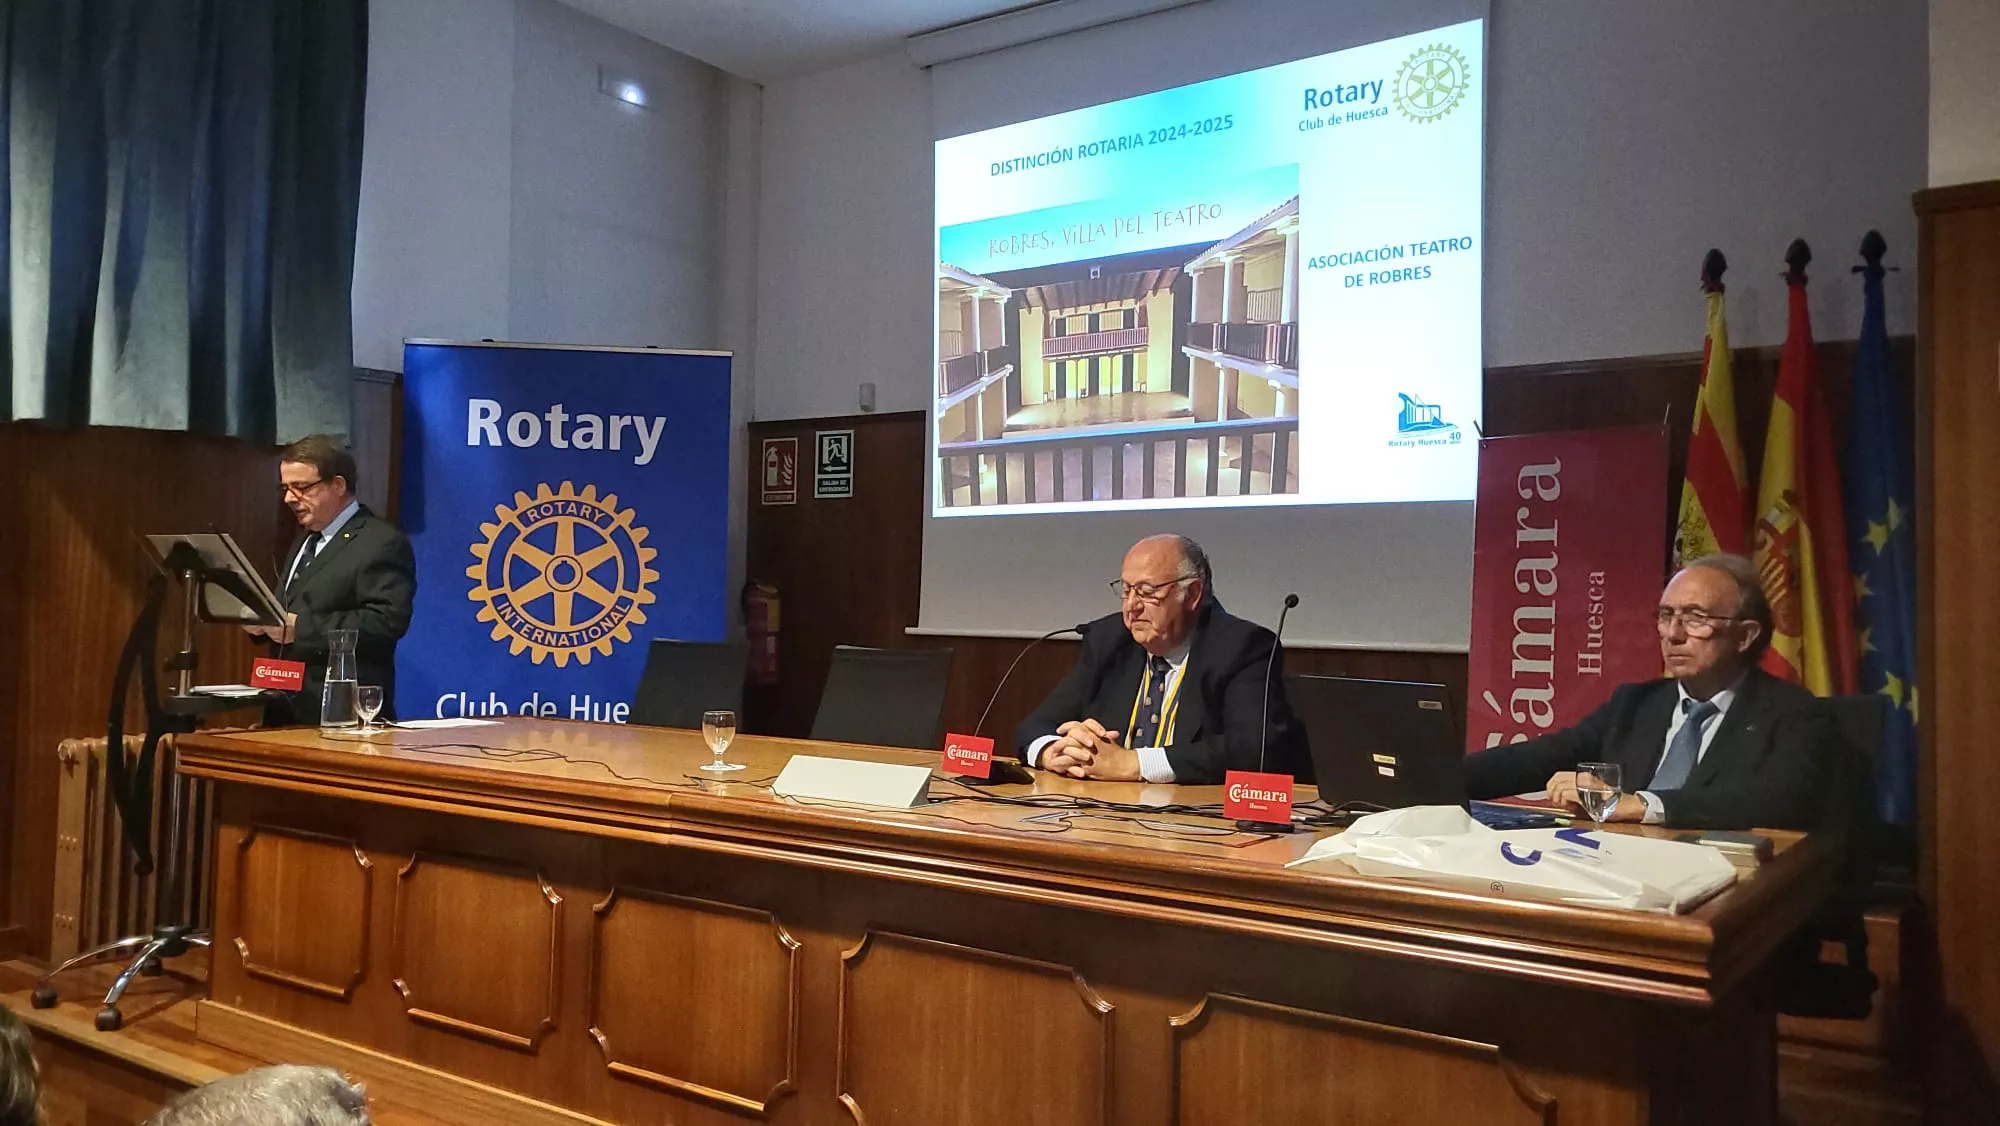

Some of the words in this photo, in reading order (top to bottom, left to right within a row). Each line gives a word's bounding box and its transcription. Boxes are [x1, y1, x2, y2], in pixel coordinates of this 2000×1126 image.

[1304, 79, 1384, 111] Rotary
[1299, 117, 1324, 131] Club
[1328, 114, 1342, 126] de
[1346, 106, 1389, 123] Huesca
[990, 145, 1073, 176] DISTINCIÓN
[1078, 134, 1144, 159] ROTARIA
[1148, 114, 1234, 145] 2024-2025
[1114, 214, 1145, 239] DEL
[1153, 203, 1223, 232] TEATRO
[1307, 244, 1404, 270] ASOCIACIÓN
[1409, 236, 1473, 257] TEATRO
[1344, 274, 1364, 288] DE
[1369, 265, 1432, 286] ROBRES
[467, 399, 667, 466] Rotary
[1388, 440, 1415, 448] Rotary
[526, 501, 606, 523] ROTARY
[1482, 456, 1562, 754] ámara
[496, 601, 630, 647] INTERNATIONAL
[1577, 571, 1606, 677] Huesca
[436, 692, 509, 719] Club
[519, 692, 557, 717] de
[570, 694, 630, 724] Hue
